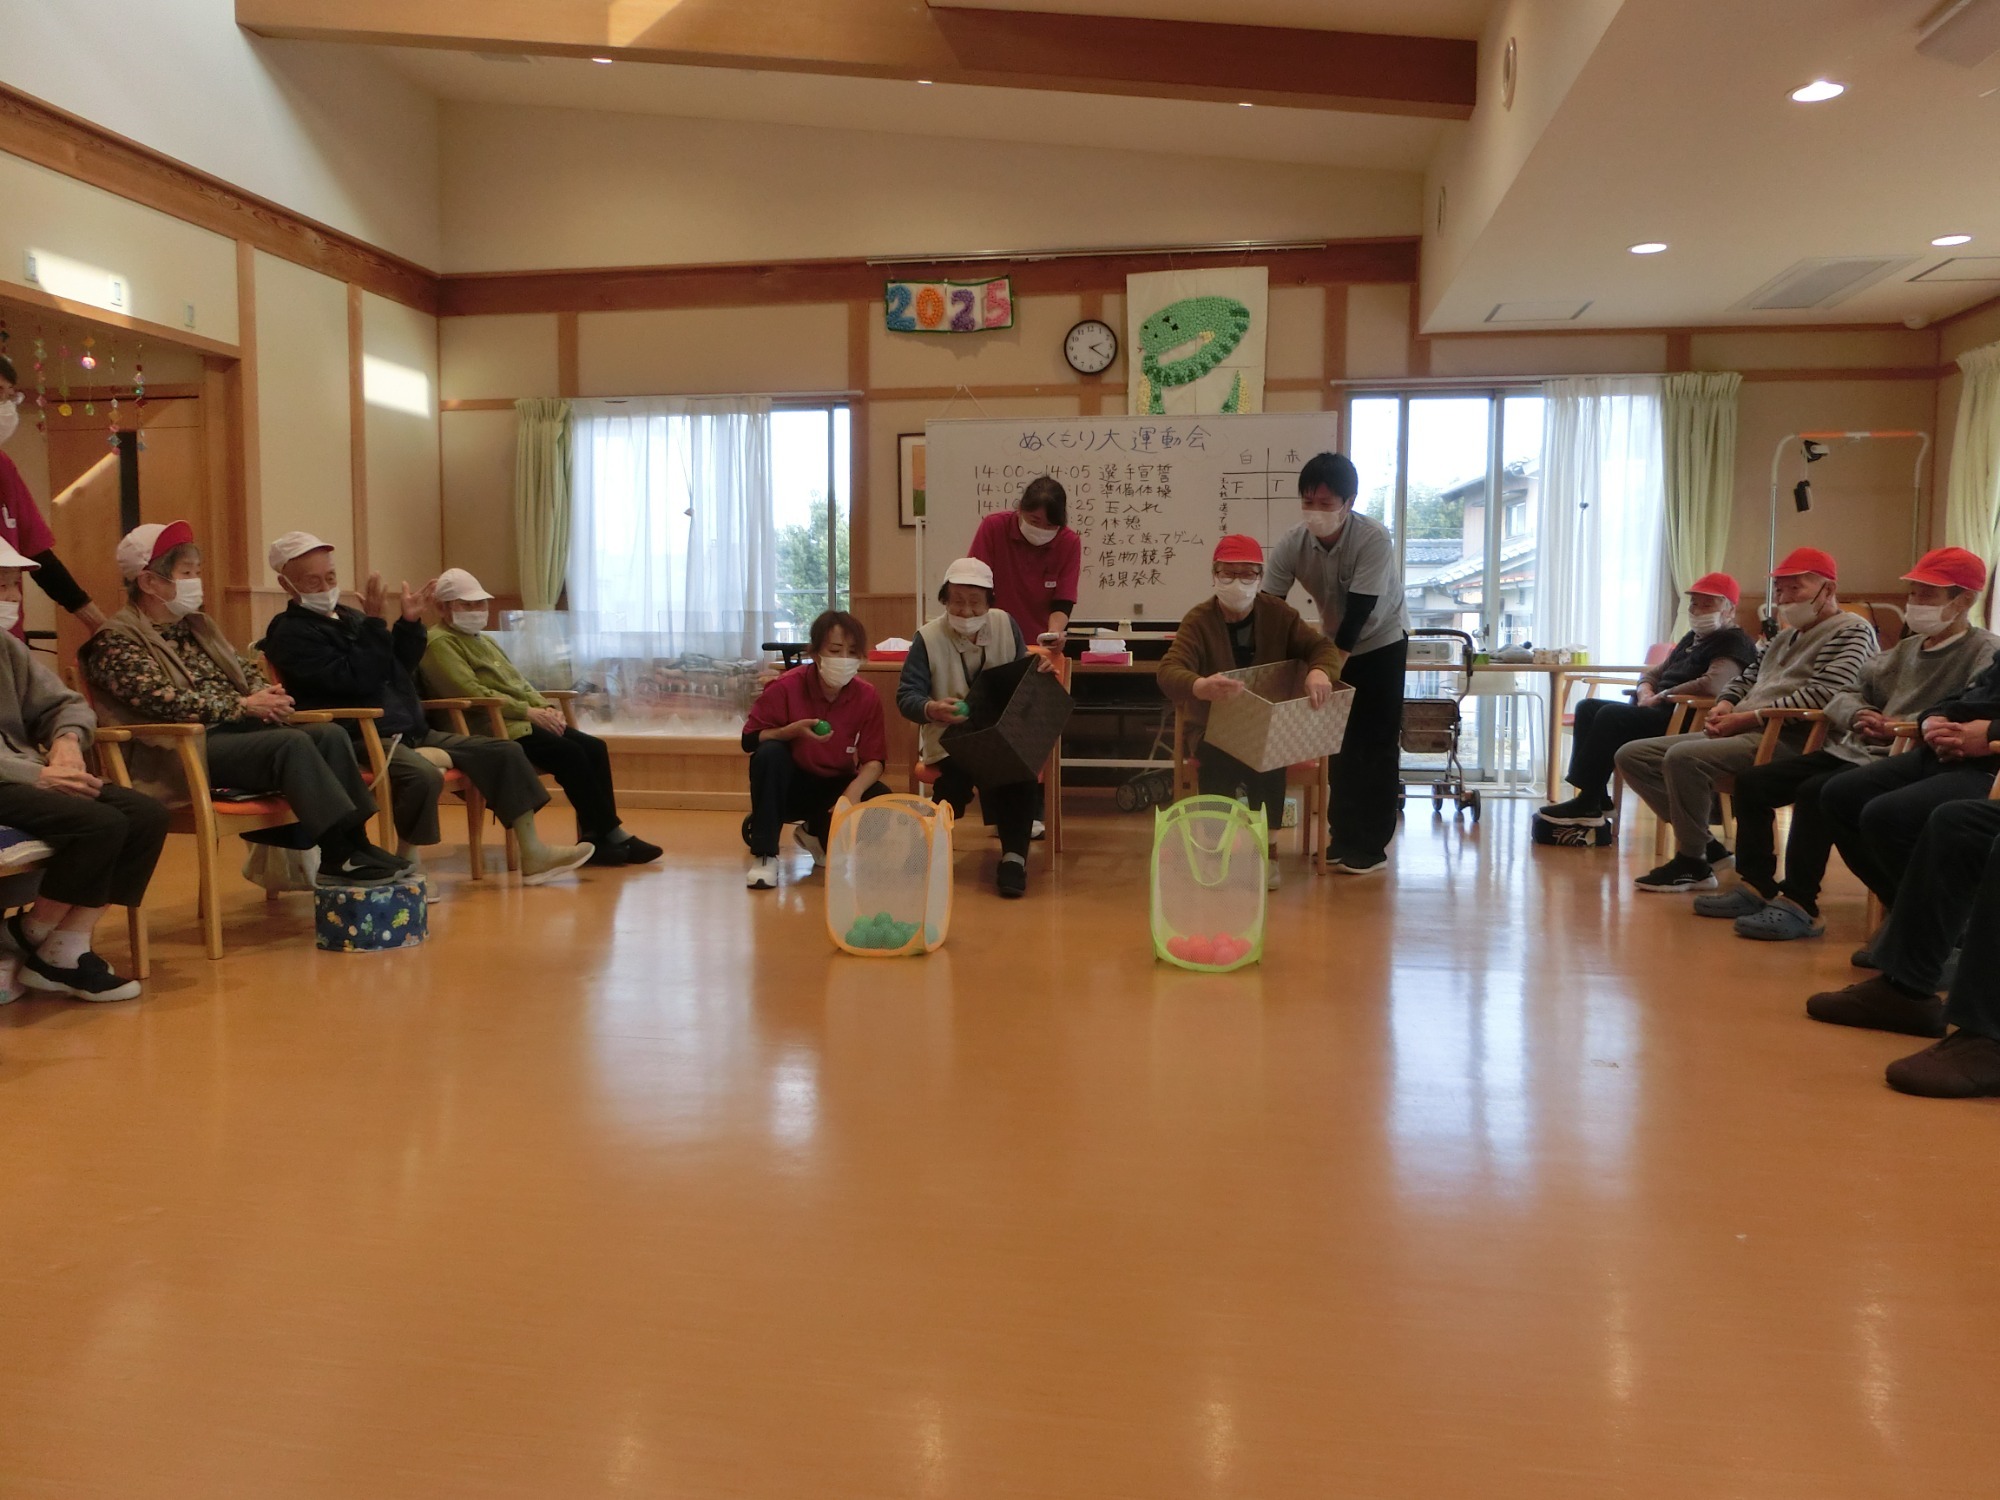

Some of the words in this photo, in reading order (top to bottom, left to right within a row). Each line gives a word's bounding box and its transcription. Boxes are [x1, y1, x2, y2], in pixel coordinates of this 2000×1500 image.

[886, 281, 1011, 332] 2025
[1019, 425, 1212, 454] ぬくもり大運動会
[1239, 449, 1252, 465] 白
[1098, 463, 1173, 483] 選手宣誓
[1100, 482, 1173, 499] 準備体操
[1104, 500, 1163, 514] 玉入れ
[1101, 515, 1141, 531] 休憩
[1099, 546, 1176, 567] 借物競争
[1098, 568, 1166, 589] 結果発表
